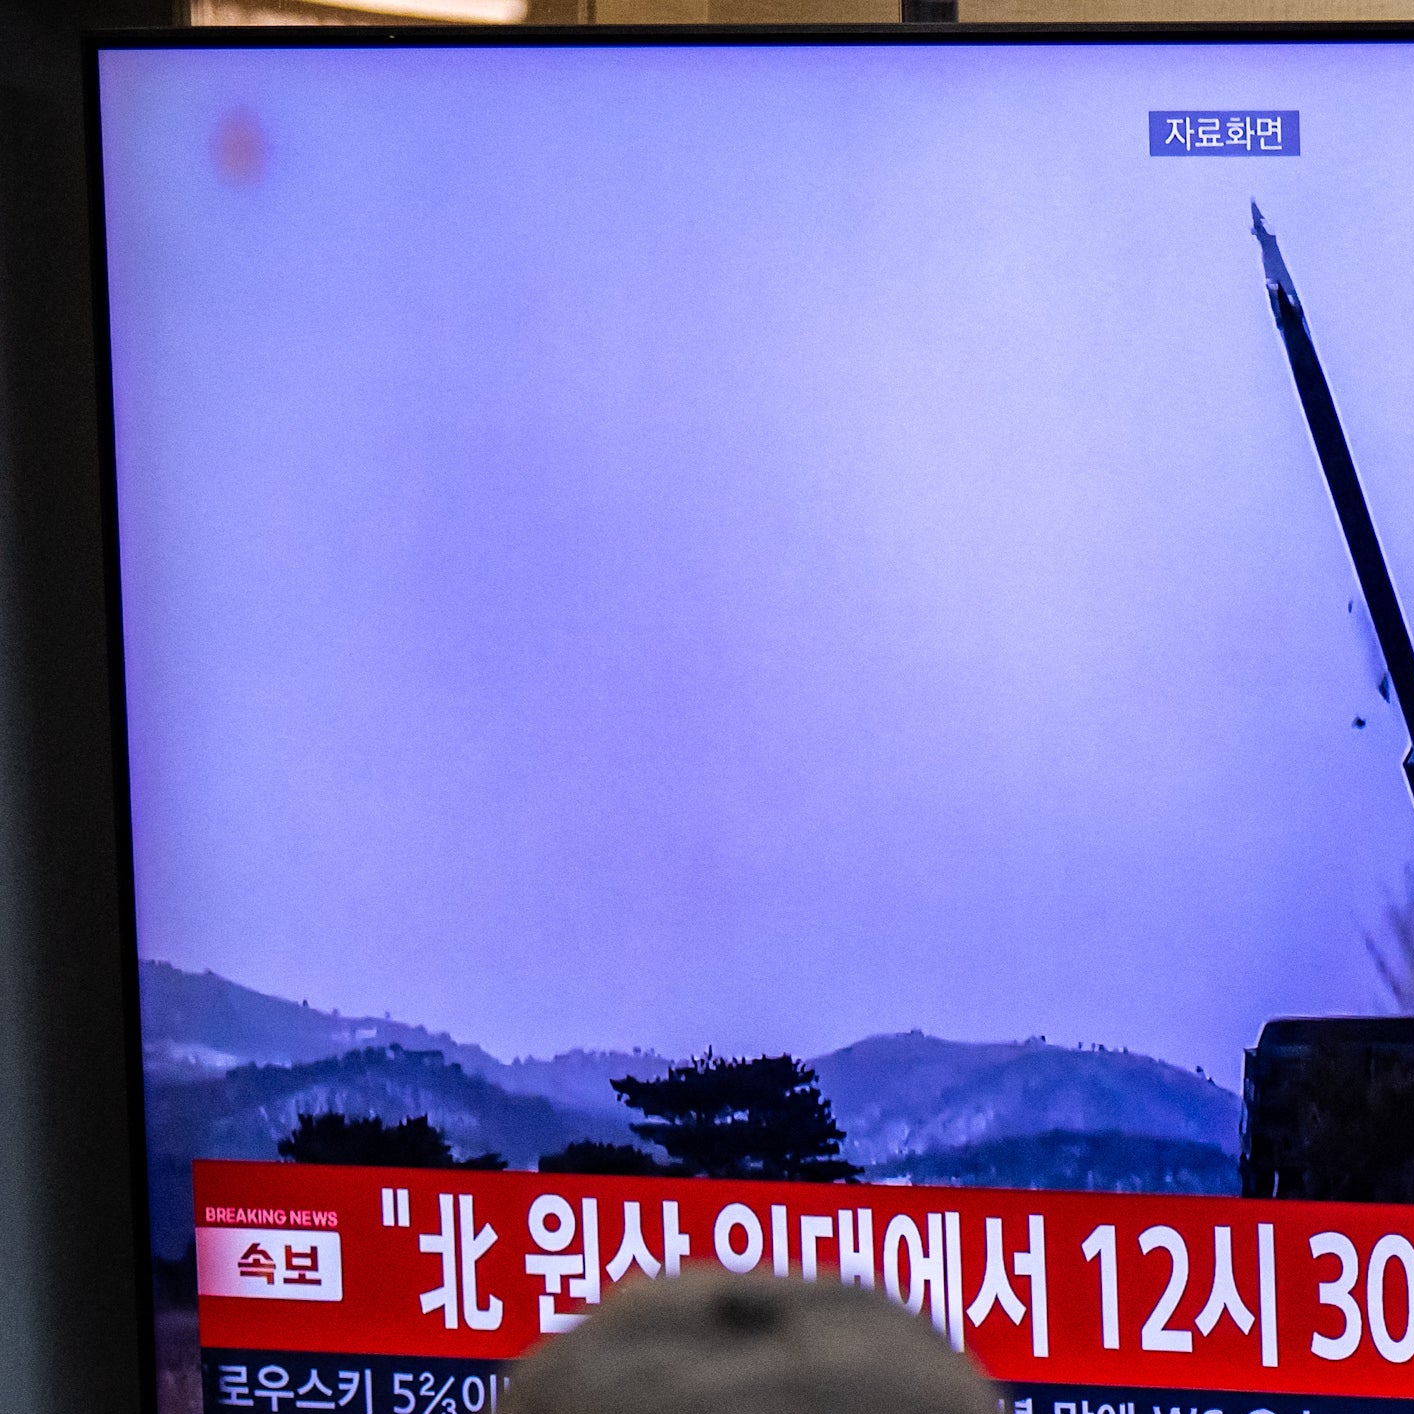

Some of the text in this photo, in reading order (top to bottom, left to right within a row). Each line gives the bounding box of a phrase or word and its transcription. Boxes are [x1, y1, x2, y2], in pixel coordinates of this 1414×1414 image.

[1164, 116, 1283, 152] 자료화면
[204, 1206, 339, 1228] BREAKING NEWS
[237, 1242, 323, 1286] 속보
[1081, 1222, 1279, 1368] 12시
